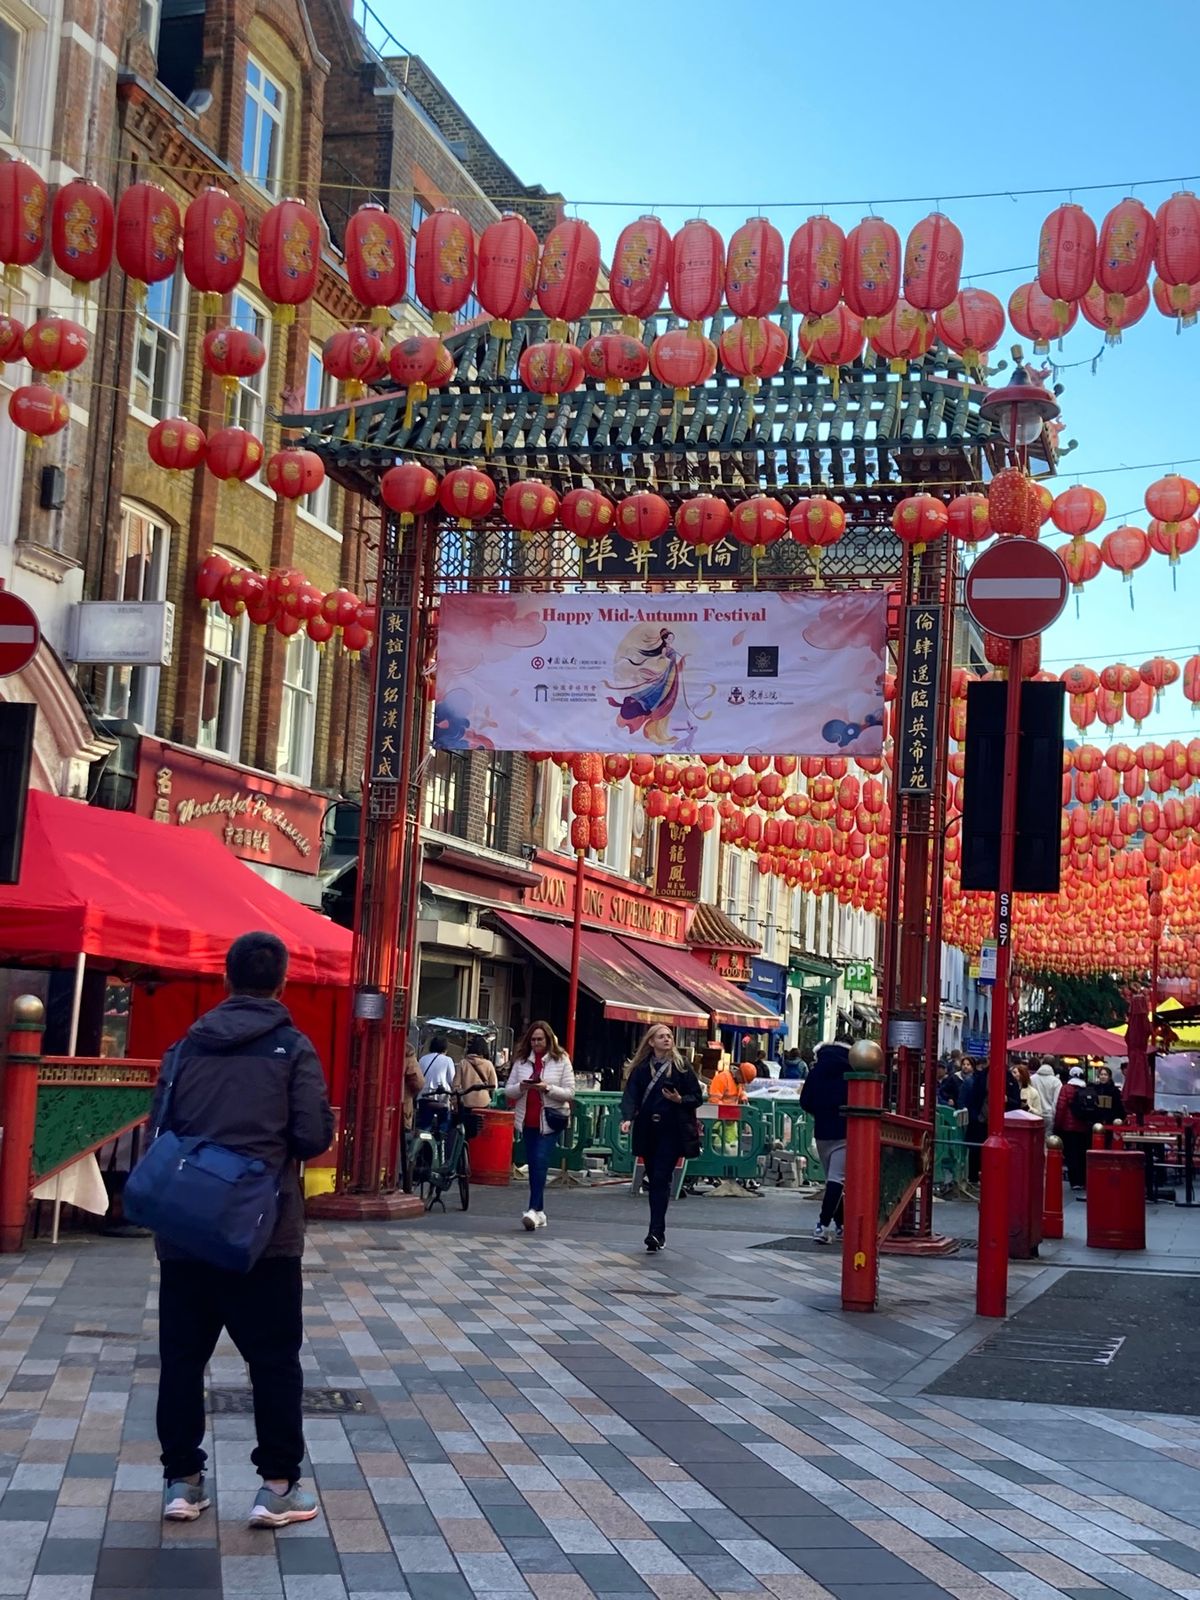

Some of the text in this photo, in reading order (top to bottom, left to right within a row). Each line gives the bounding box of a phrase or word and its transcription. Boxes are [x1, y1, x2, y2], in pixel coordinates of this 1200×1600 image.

[542, 607, 767, 625] Happy Mid-Autumn Festival
[177, 791, 253, 825] Wonderful
[667, 881, 687, 890] NEW
[579, 887, 605, 918] UNG
[610, 896, 682, 939] SUPERMARKET
